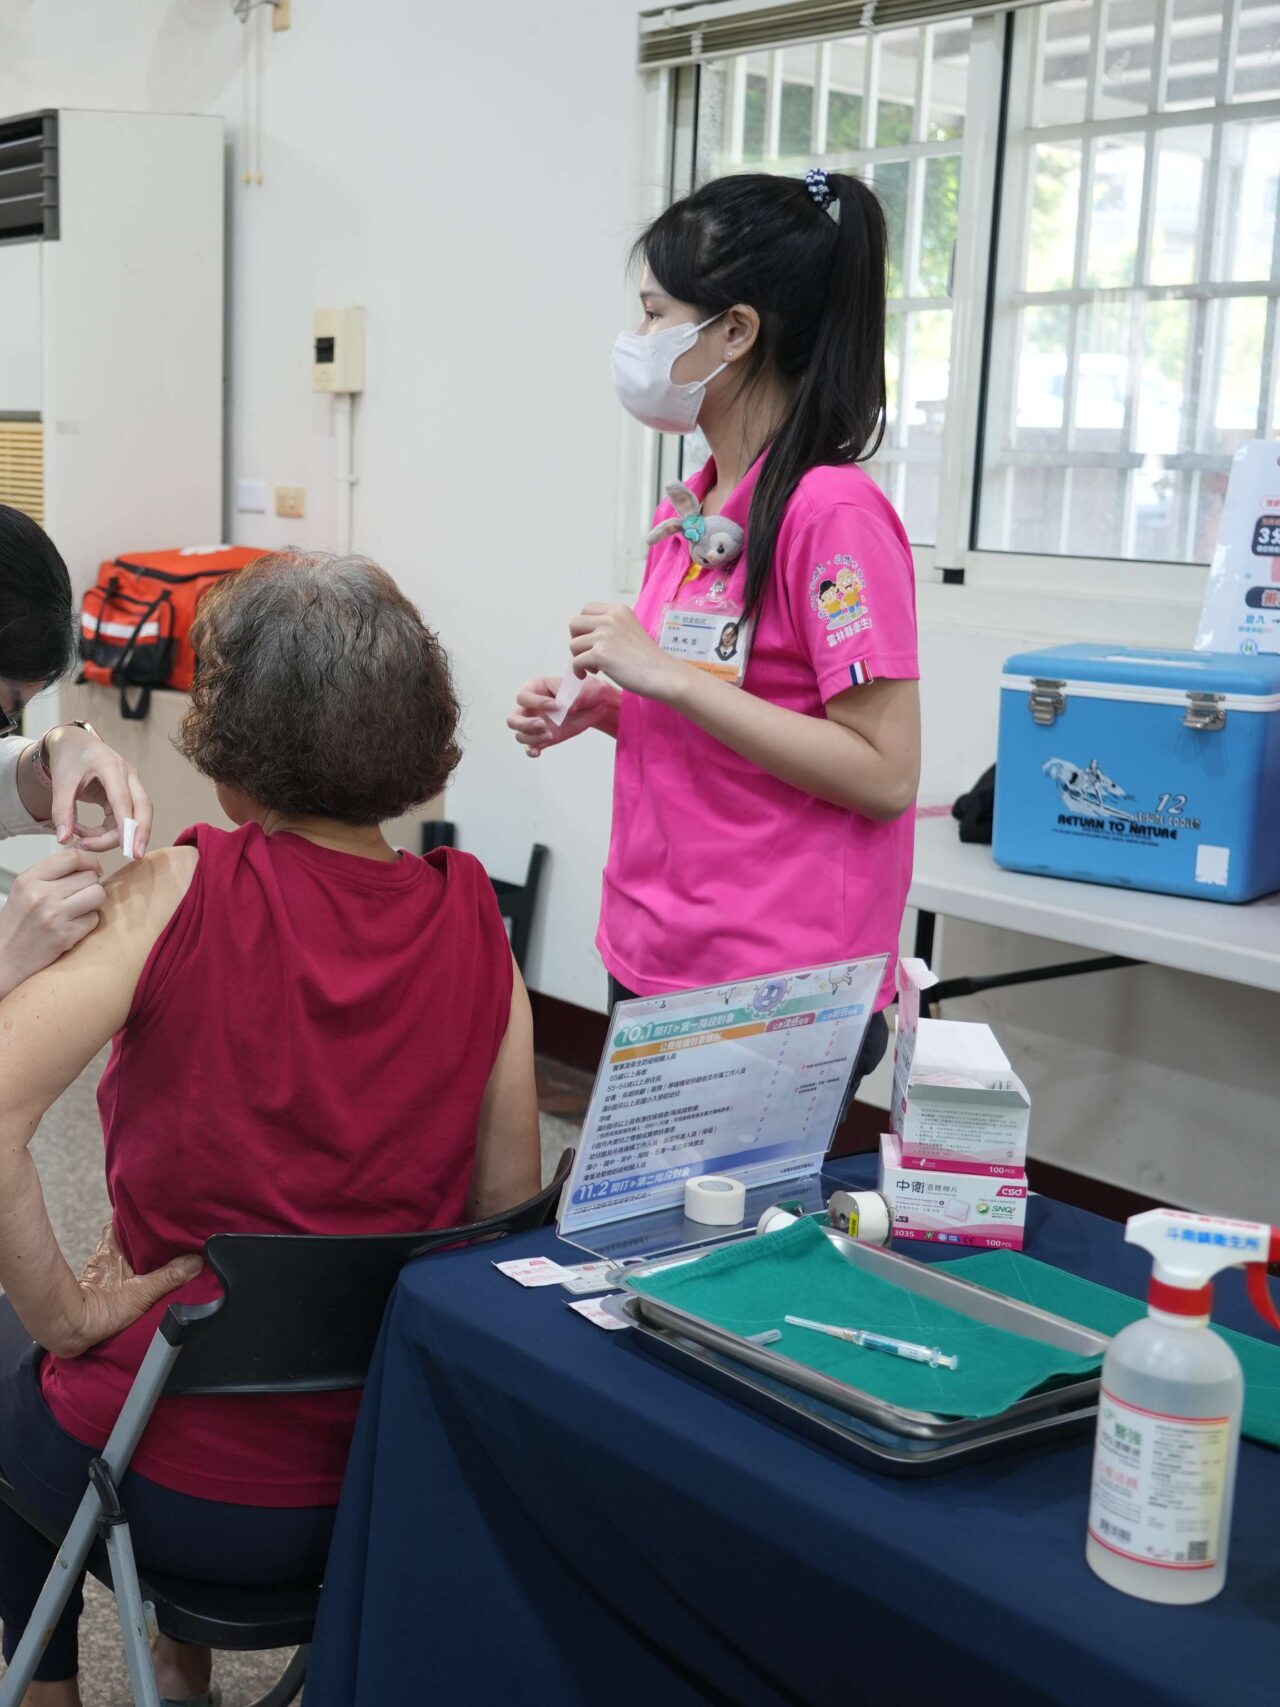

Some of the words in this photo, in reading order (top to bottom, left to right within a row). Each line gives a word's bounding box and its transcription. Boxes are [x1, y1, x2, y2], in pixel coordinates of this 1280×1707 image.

[826, 618, 872, 647] 雲林縣衛生
[1156, 793, 1188, 814] 12
[1057, 814, 1104, 830] RETURN
[1109, 820, 1125, 832] TO
[1129, 822, 1178, 840] NATURE
[619, 1022, 652, 1044] 10.1
[989, 1166, 1004, 1174] 100
[577, 1179, 610, 1202] 11.2
[896, 1180, 925, 1194] 中衛
[894, 1229, 915, 1237] 3035
[986, 1239, 1001, 1247] 100
